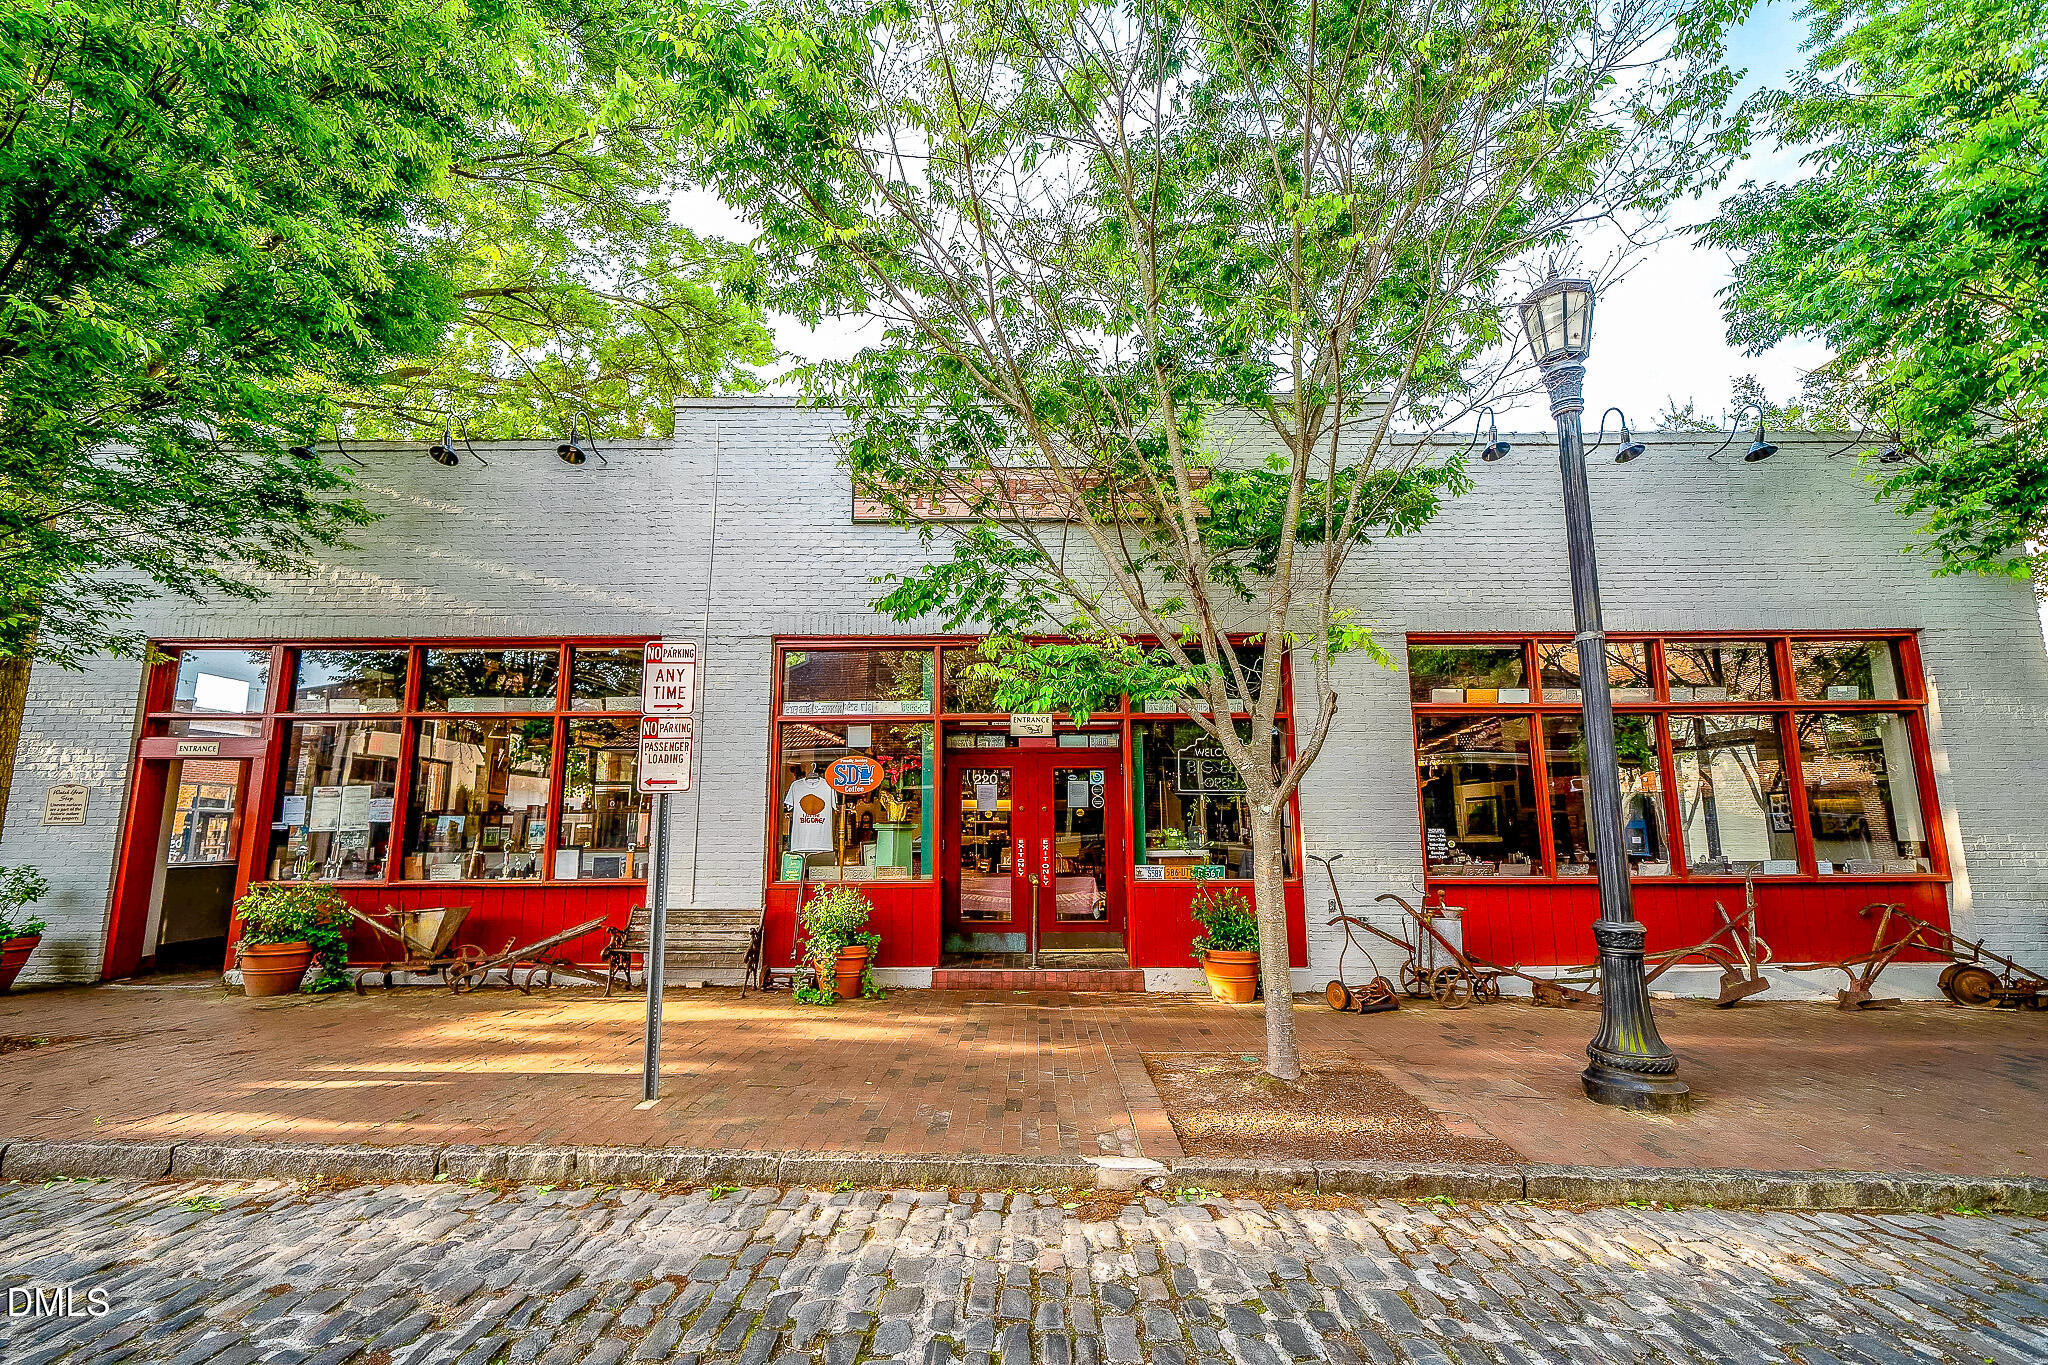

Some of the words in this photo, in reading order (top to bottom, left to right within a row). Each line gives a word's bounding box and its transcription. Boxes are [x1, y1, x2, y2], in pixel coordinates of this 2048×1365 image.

[648, 646, 662, 660] NO
[663, 648, 694, 658] PARKING
[656, 669, 685, 682] ANY
[653, 686, 686, 700] TIME
[1013, 716, 1050, 724] ENTRANCE
[643, 721, 658, 736] NO
[659, 723, 691, 733] PARKING
[644, 742, 689, 752] PASSENGER
[1195, 748, 1229, 757] WELCO
[648, 753, 684, 764] LOADING
[834, 764, 859, 786] SD
[974, 774, 998, 784] 220
[844, 785, 865, 793] Coffee
[1017, 858, 1025, 877] ONLY
[1041, 863, 1050, 886] ONLY
